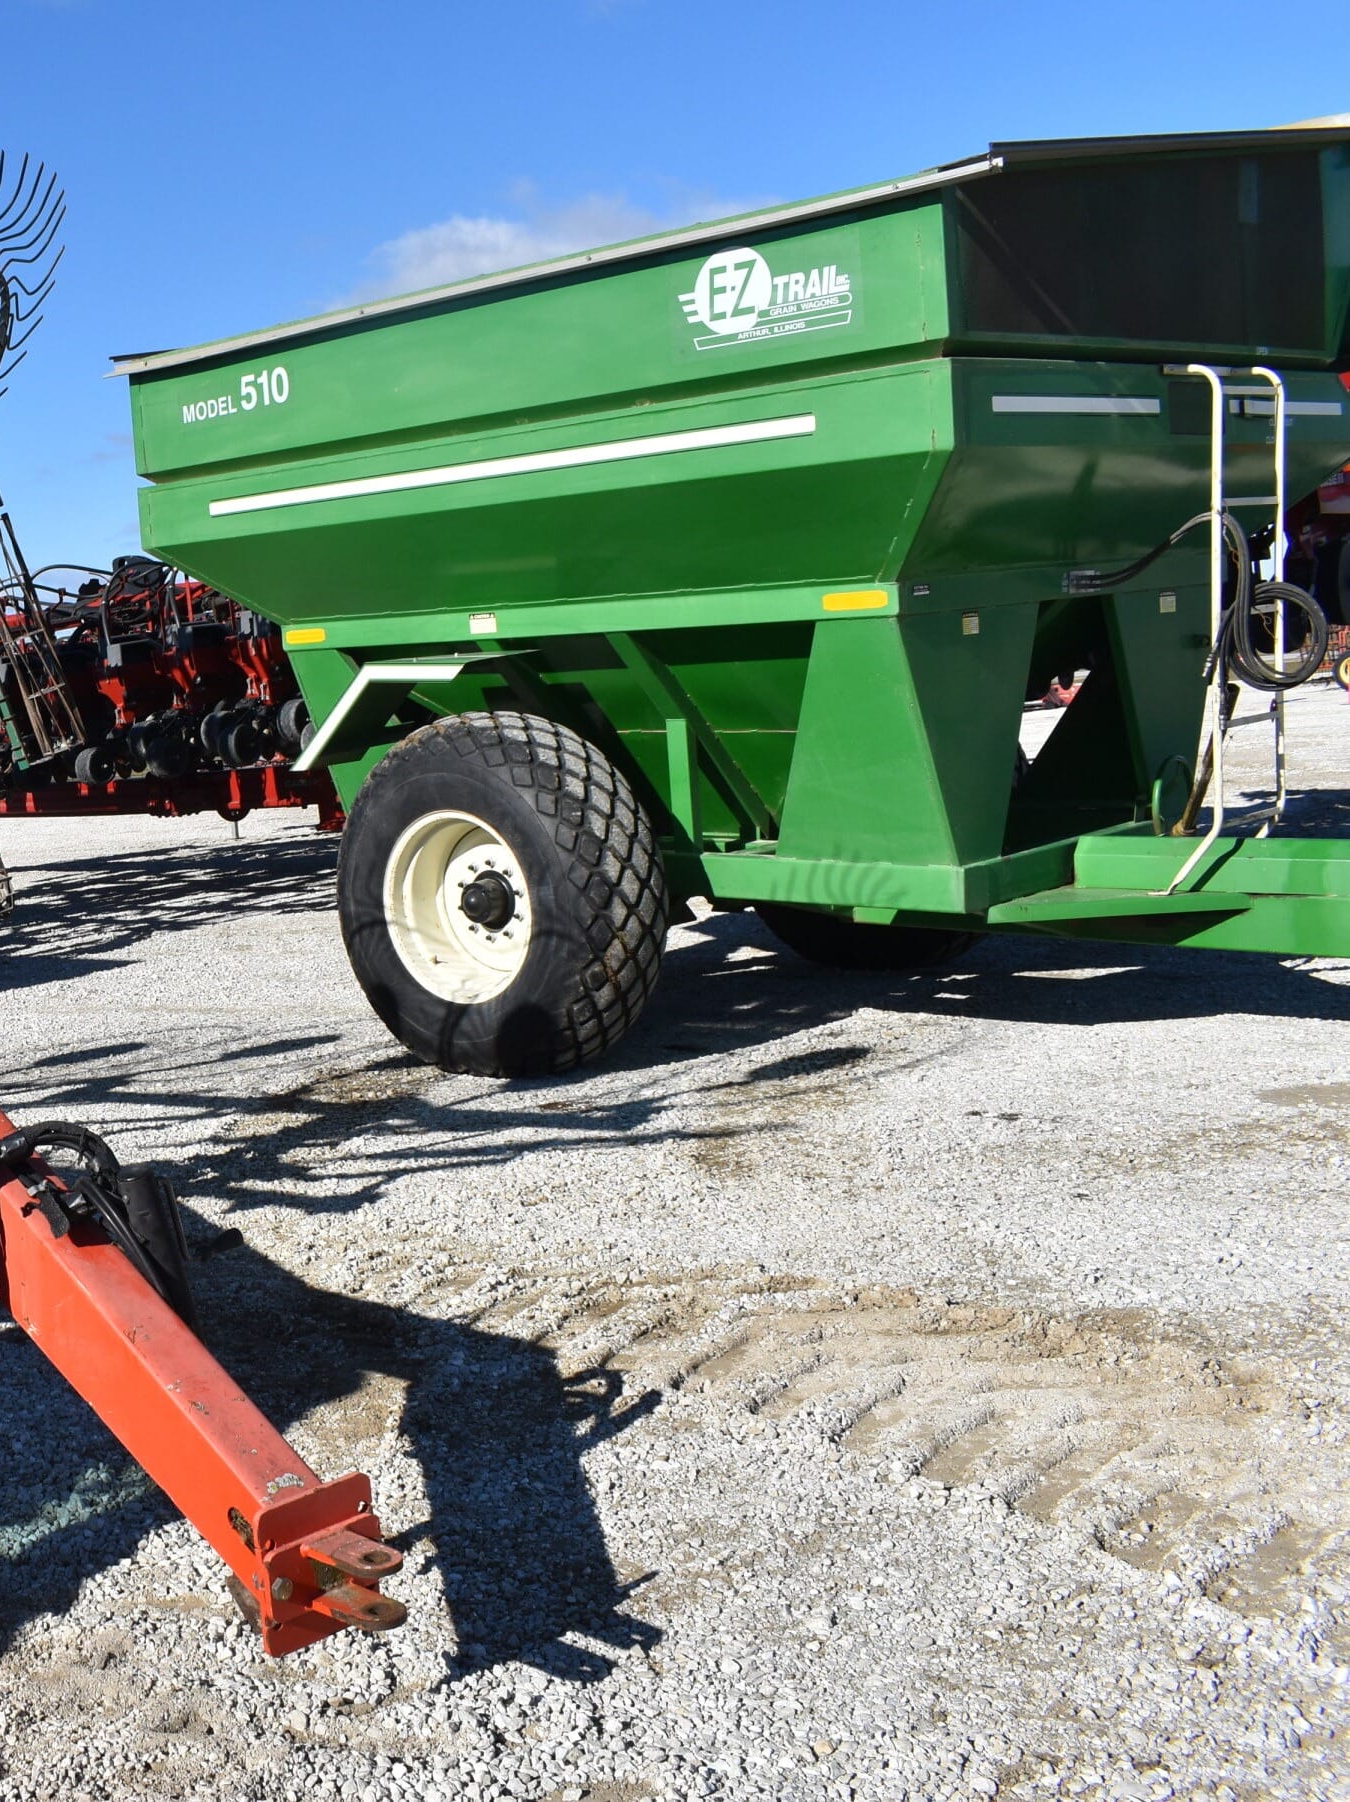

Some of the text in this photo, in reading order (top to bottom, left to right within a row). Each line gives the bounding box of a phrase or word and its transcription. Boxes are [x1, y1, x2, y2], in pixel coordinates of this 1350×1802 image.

[772, 264, 850, 305] TRAIL
[769, 296, 840, 317] GRAIN WAGONS
[773, 321, 806, 334] ILLINOIS
[182, 366, 290, 424] MODEL 510
